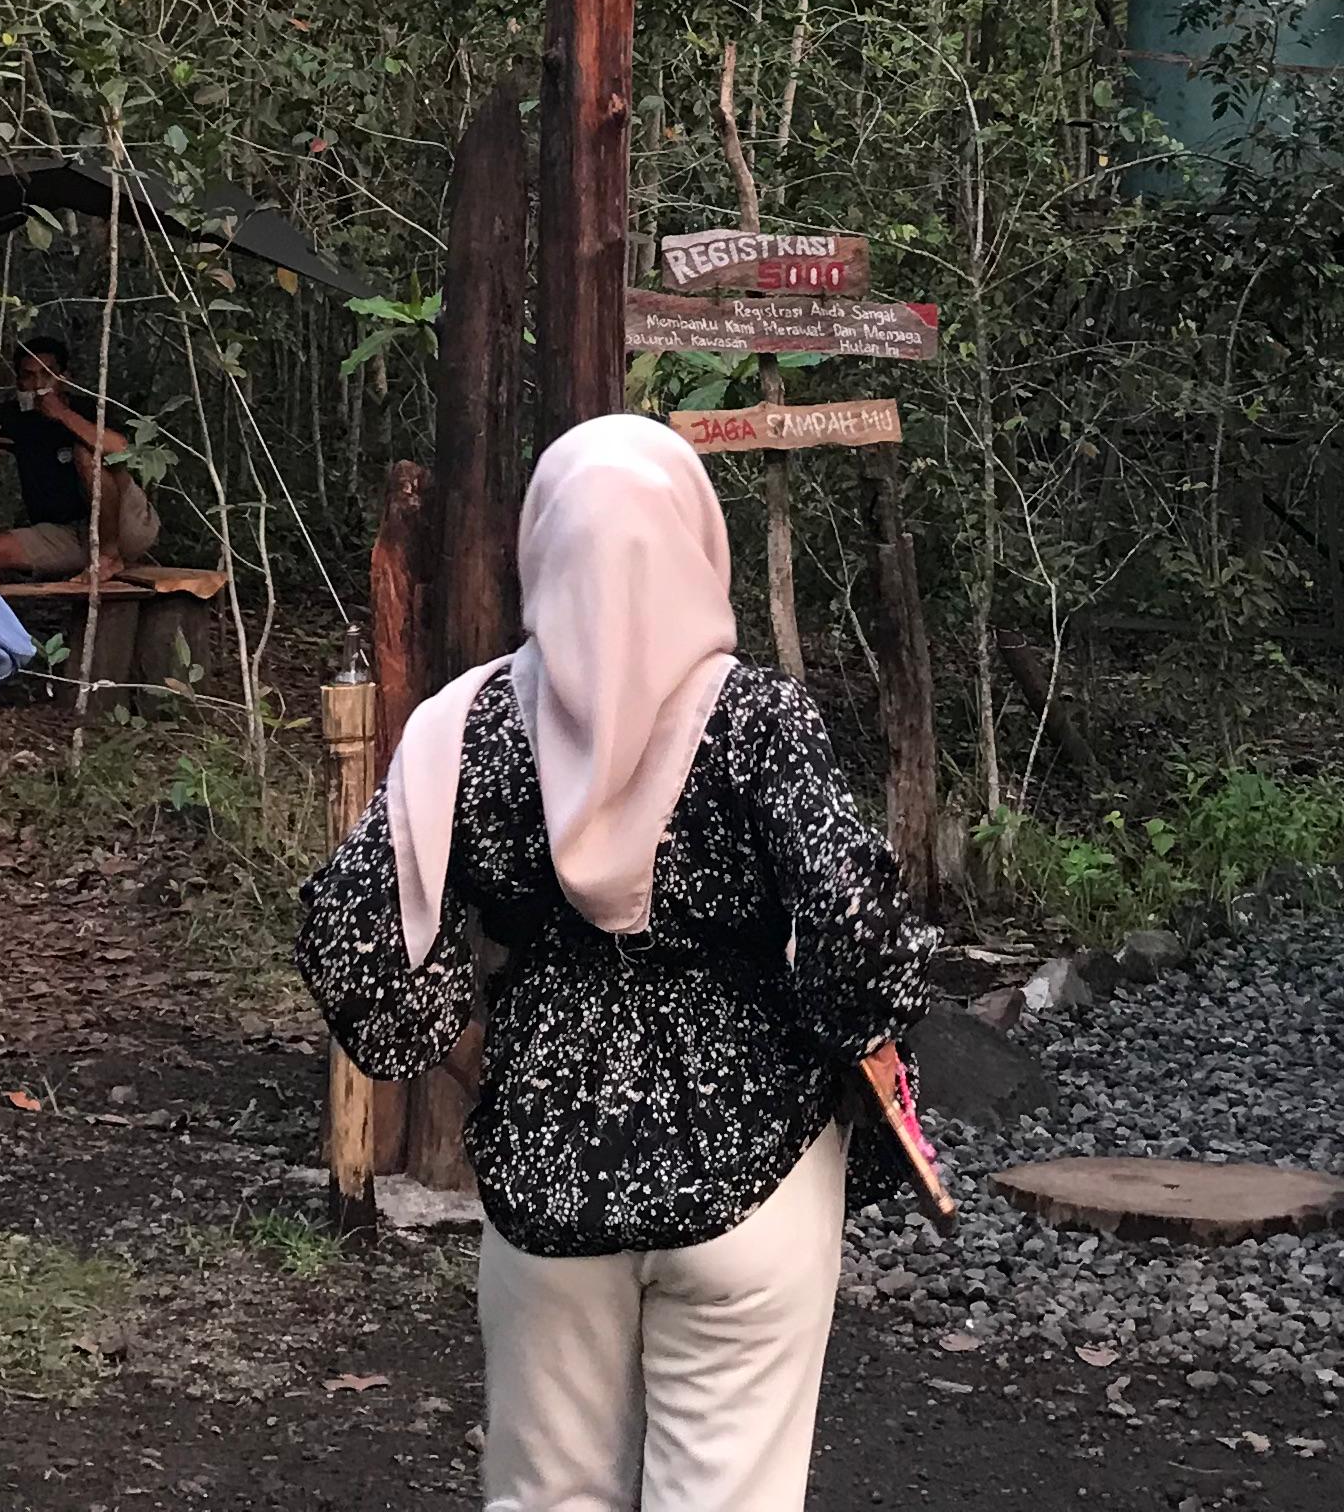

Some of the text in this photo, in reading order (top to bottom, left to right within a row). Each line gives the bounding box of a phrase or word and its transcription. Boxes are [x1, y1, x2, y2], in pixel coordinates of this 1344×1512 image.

[757, 261, 846, 290] 5000
[646, 314, 718, 333] Membantu
[725, 319, 755, 335] Kami
[763, 319, 825, 338] Merawat
[833, 322, 858, 338] Dan
[734, 300, 897, 326] Registrasi Anda Sangat
[839, 338, 882, 356] Hutan
[690, 409, 893, 444] JAGA SAMPAH MU
